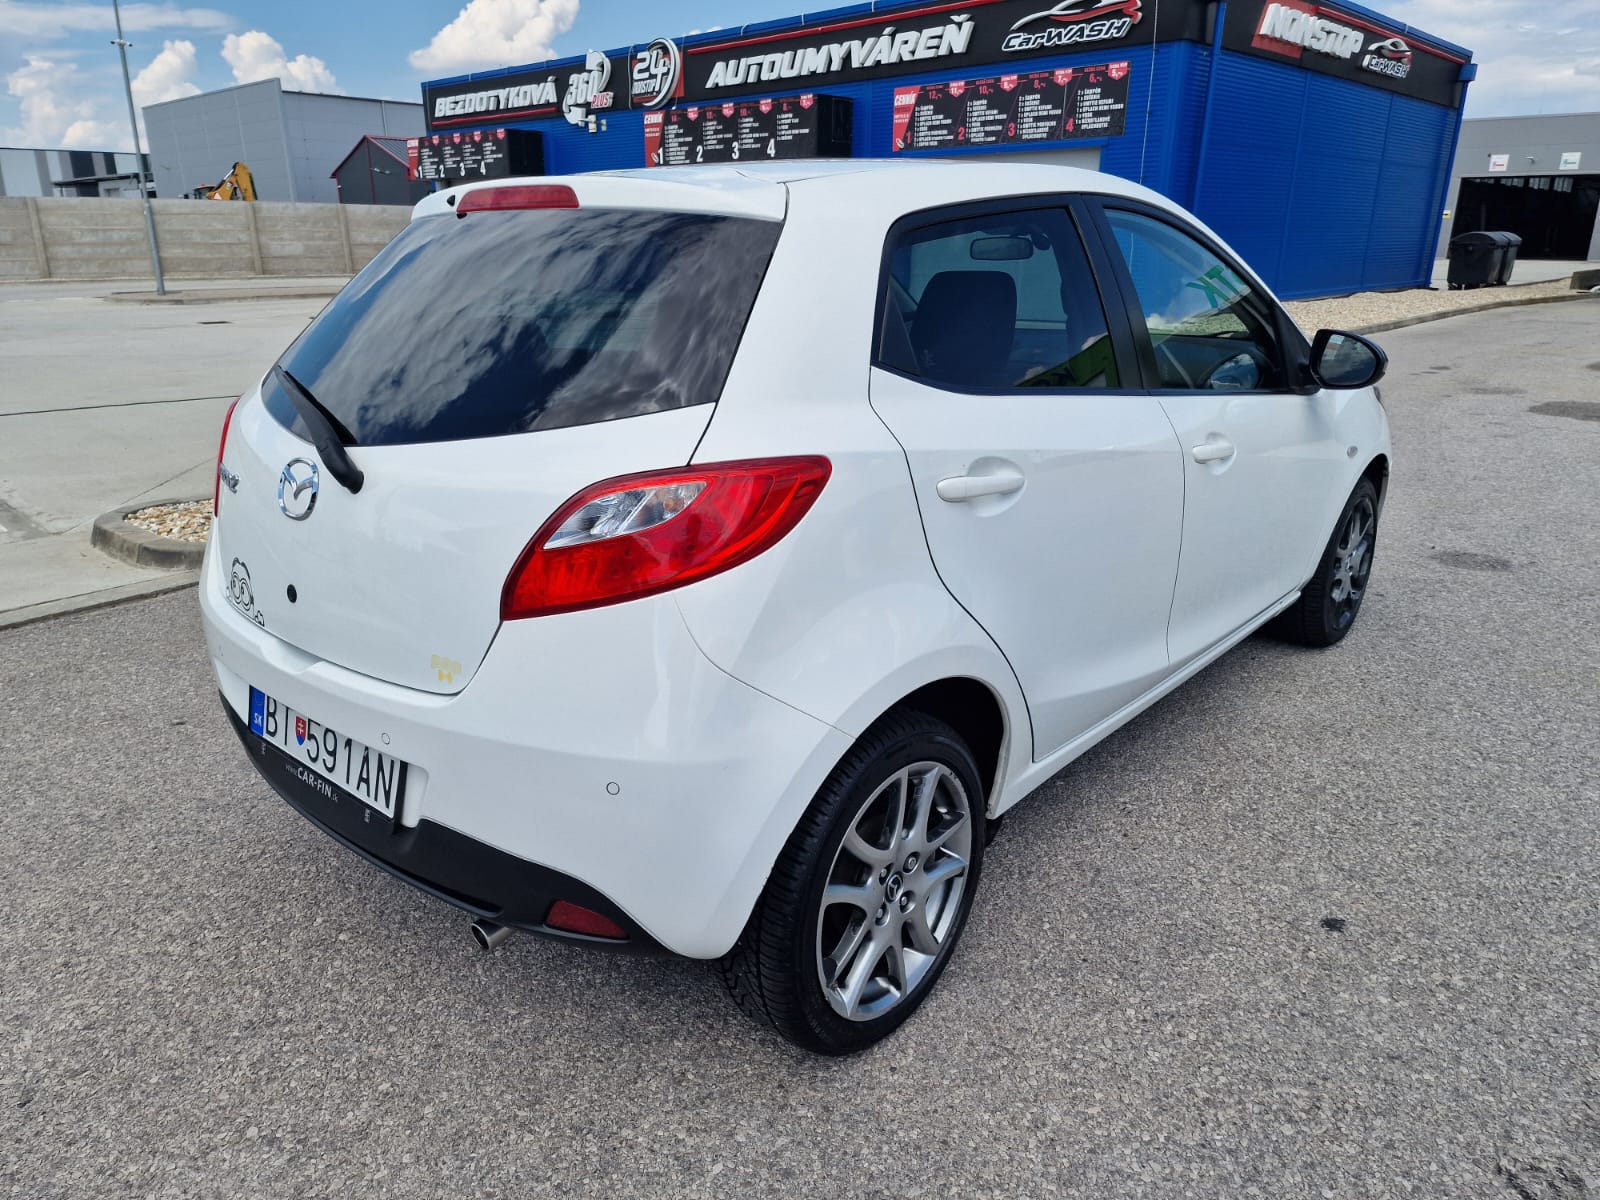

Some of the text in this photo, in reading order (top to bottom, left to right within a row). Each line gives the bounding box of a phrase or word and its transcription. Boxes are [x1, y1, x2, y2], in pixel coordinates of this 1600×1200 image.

[1001, 18, 1133, 51] CarWASH
[1259, 2, 1364, 59] NONSTOP
[704, 15, 975, 89] AUTOUMYVÁREŇ
[633, 51, 668, 92] 24
[434, 76, 557, 118] BEZDOTYKOVÁ
[567, 71, 602, 106] 360
[591, 91, 614, 109] PLUS
[1008, 122, 1016, 137] 3
[1065, 117, 1075, 133] 4
[906, 131, 911, 144] 1
[958, 127, 965, 141] 2
[658, 147, 663, 164] 1
[696, 145, 703, 162] 2
[732, 141, 739, 159] 3
[767, 138, 775, 157] 4
[418, 165, 423, 179] 1
[439, 164, 445, 178] 2
[459, 162, 465, 177] 3
[480, 160, 486, 176] 4
[254, 712, 263, 728] SK
[306, 718, 395, 810] 591AN
